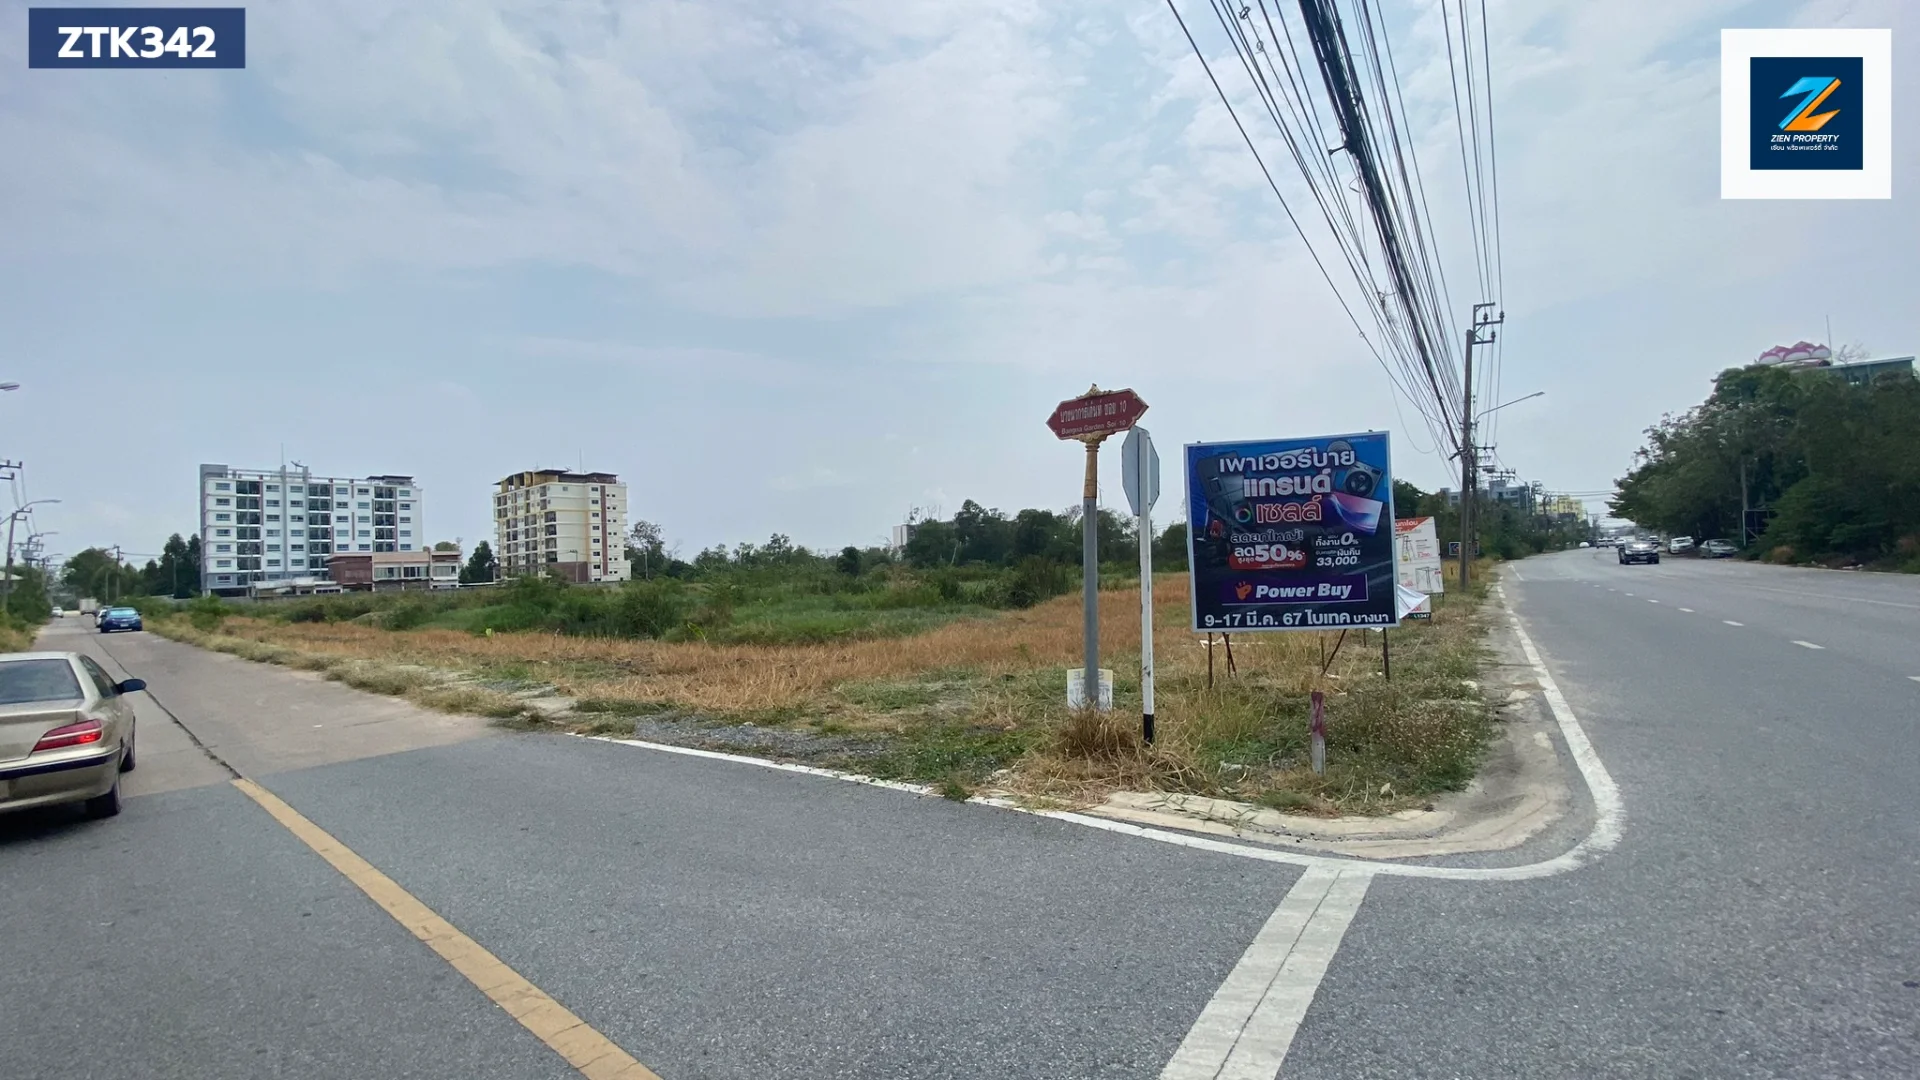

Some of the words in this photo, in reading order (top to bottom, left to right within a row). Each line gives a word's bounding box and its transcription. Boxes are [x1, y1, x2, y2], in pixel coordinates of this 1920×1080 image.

[1119, 400, 1127, 413] 10
[1083, 423, 1105, 432] Garden
[1106, 420, 1117, 428] Soi
[1219, 448, 1356, 472] เพาเวอร์บาย
[1243, 468, 1332, 498] แกรนด์
[1234, 546, 1255, 557] ลด
[1255, 585, 1315, 598] Power
[1317, 583, 1352, 599] Buy
[1246, 611, 1279, 626] มี.ค.
[1282, 612, 1302, 625] 67
[1305, 609, 1350, 625] ไบเทค
[1353, 613, 1389, 623] บางนา
